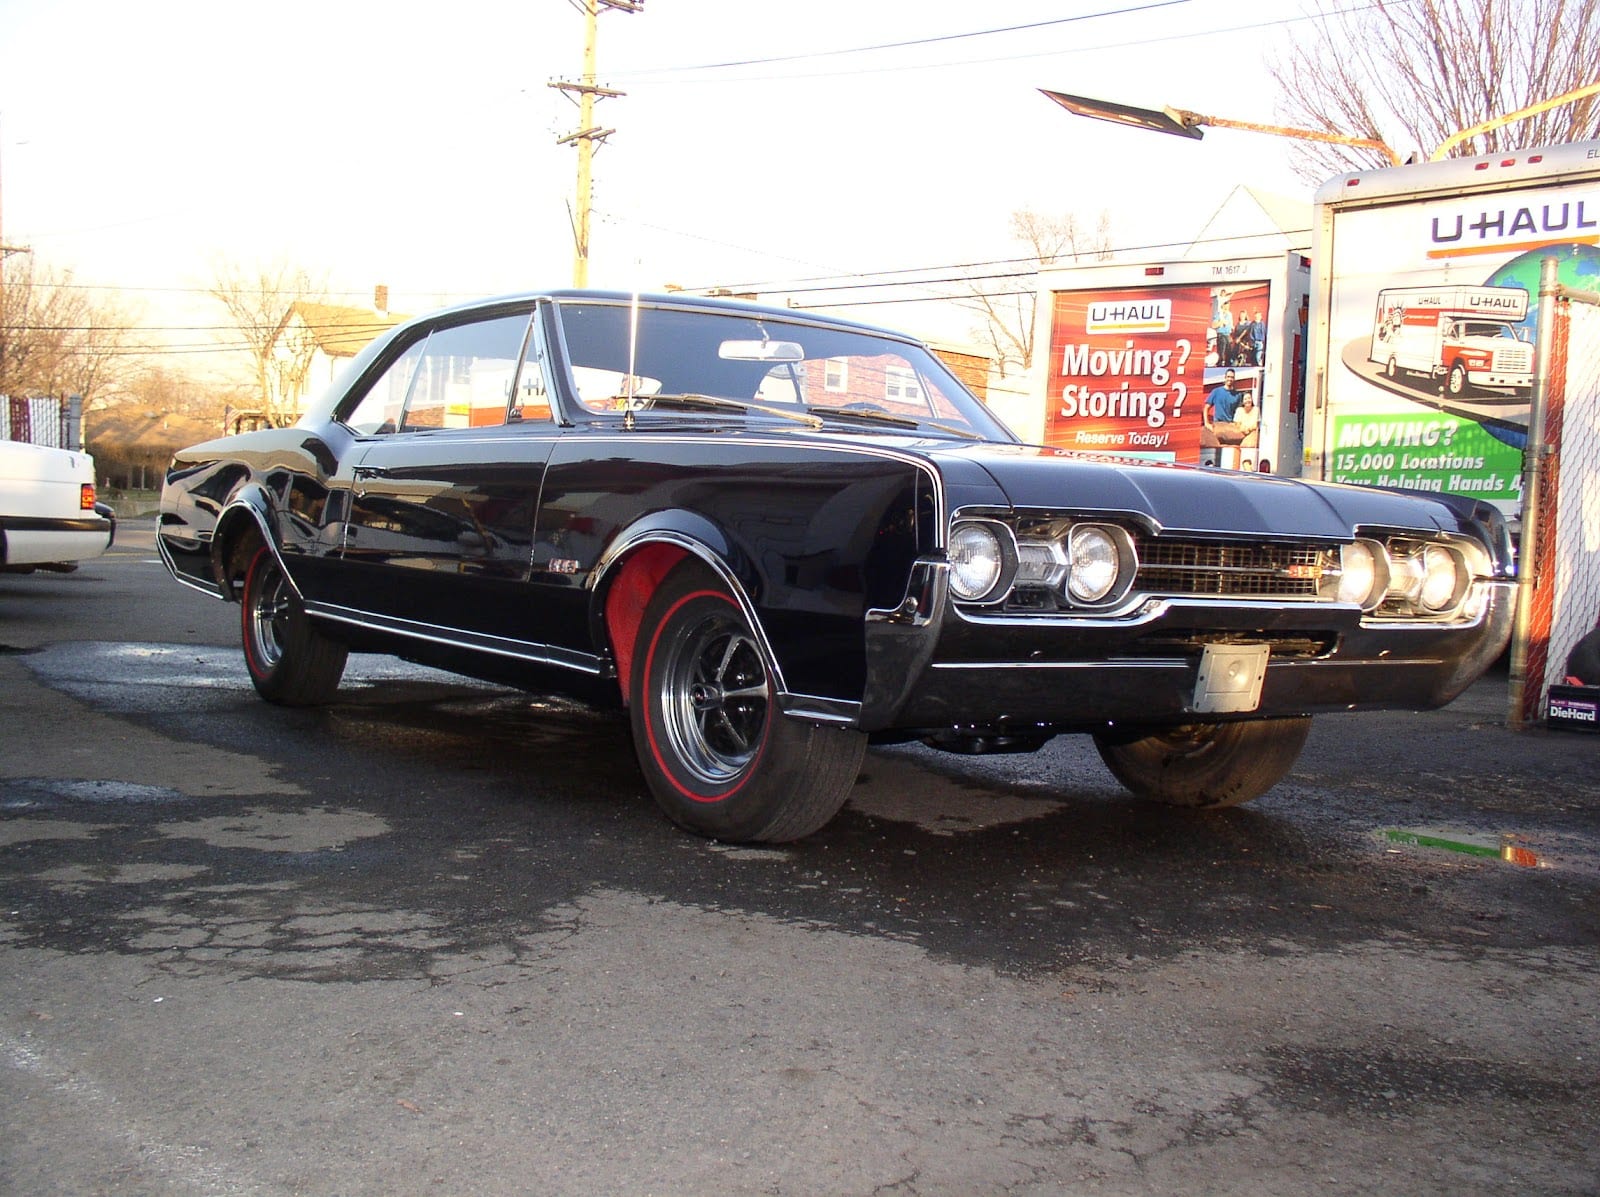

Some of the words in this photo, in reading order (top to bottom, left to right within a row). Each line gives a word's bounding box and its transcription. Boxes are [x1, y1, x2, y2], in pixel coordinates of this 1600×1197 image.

[1432, 201, 1597, 243] U-HAUL
[1470, 296, 1519, 308] U-HAUL
[1091, 304, 1166, 322] U-HAUL
[1061, 339, 1192, 386] Moving?
[1061, 382, 1188, 428] Storing?
[1075, 431, 1125, 444] Reserve
[1127, 431, 1170, 448] Today!
[1339, 419, 1460, 448] MOVING?
[1335, 453, 1395, 473] 15,000
[1400, 453, 1485, 471] Locations
[1376, 474, 1443, 493] Helping
[1447, 473, 1504, 491] Hands
[1550, 706, 1596, 721] DieHard
